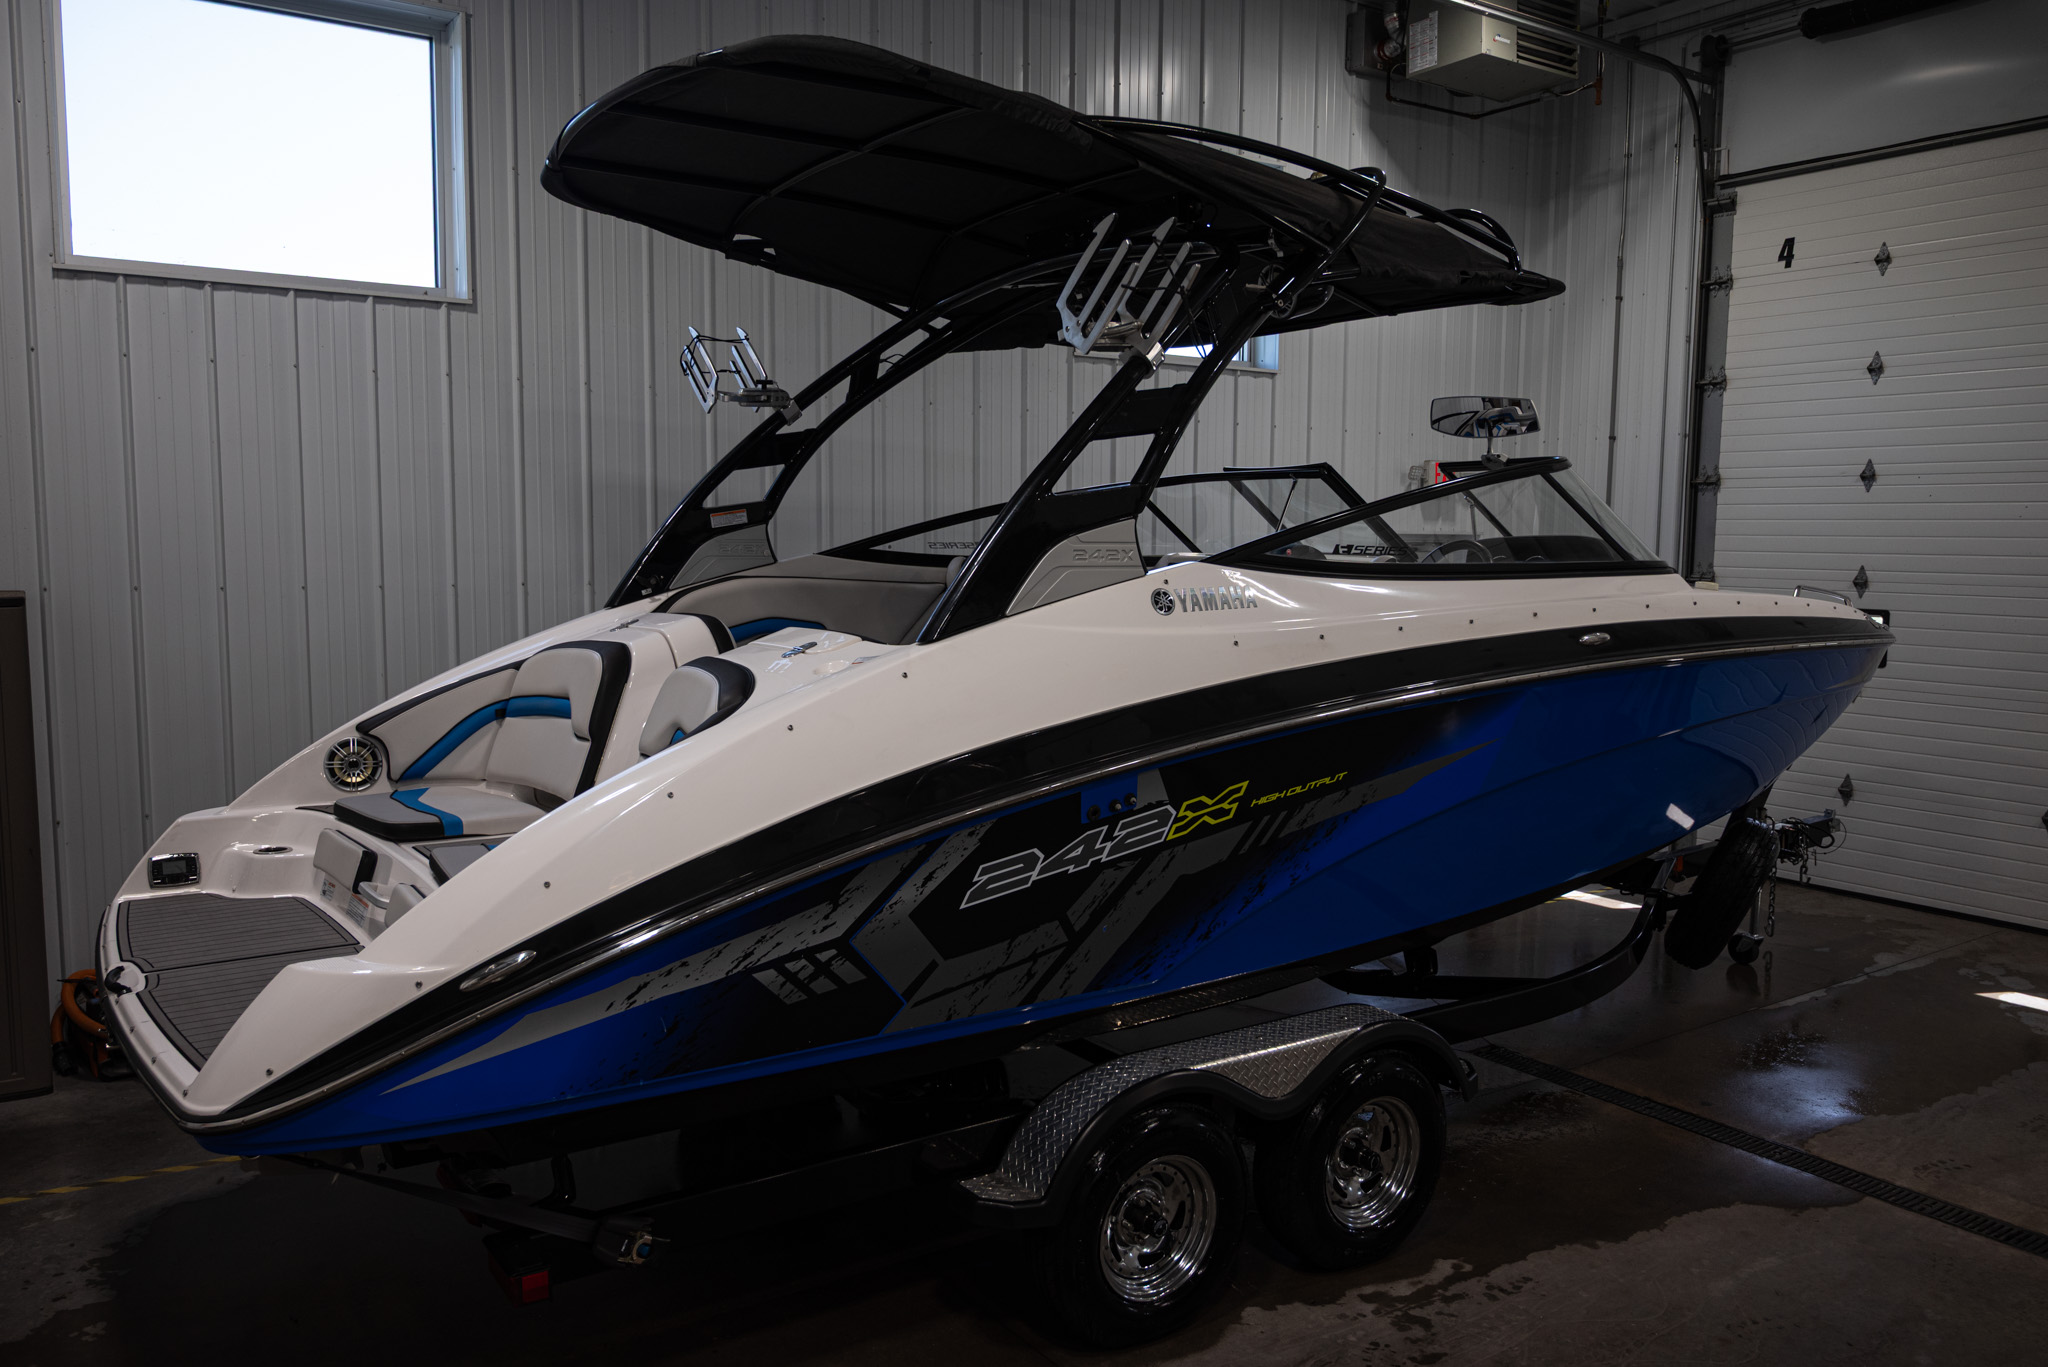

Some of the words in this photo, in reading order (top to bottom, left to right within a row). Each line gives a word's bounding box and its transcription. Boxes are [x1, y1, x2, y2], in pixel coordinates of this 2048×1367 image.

[1778, 237, 1795, 269] 4
[1073, 548, 1134, 562] 242X
[1350, 545, 1409, 556] SERIES
[1174, 585, 1258, 613] YAMAHA
[959, 780, 1249, 909] 242X
[1250, 791, 1287, 808] HIGH
[1286, 771, 1349, 797] OUTPUT
